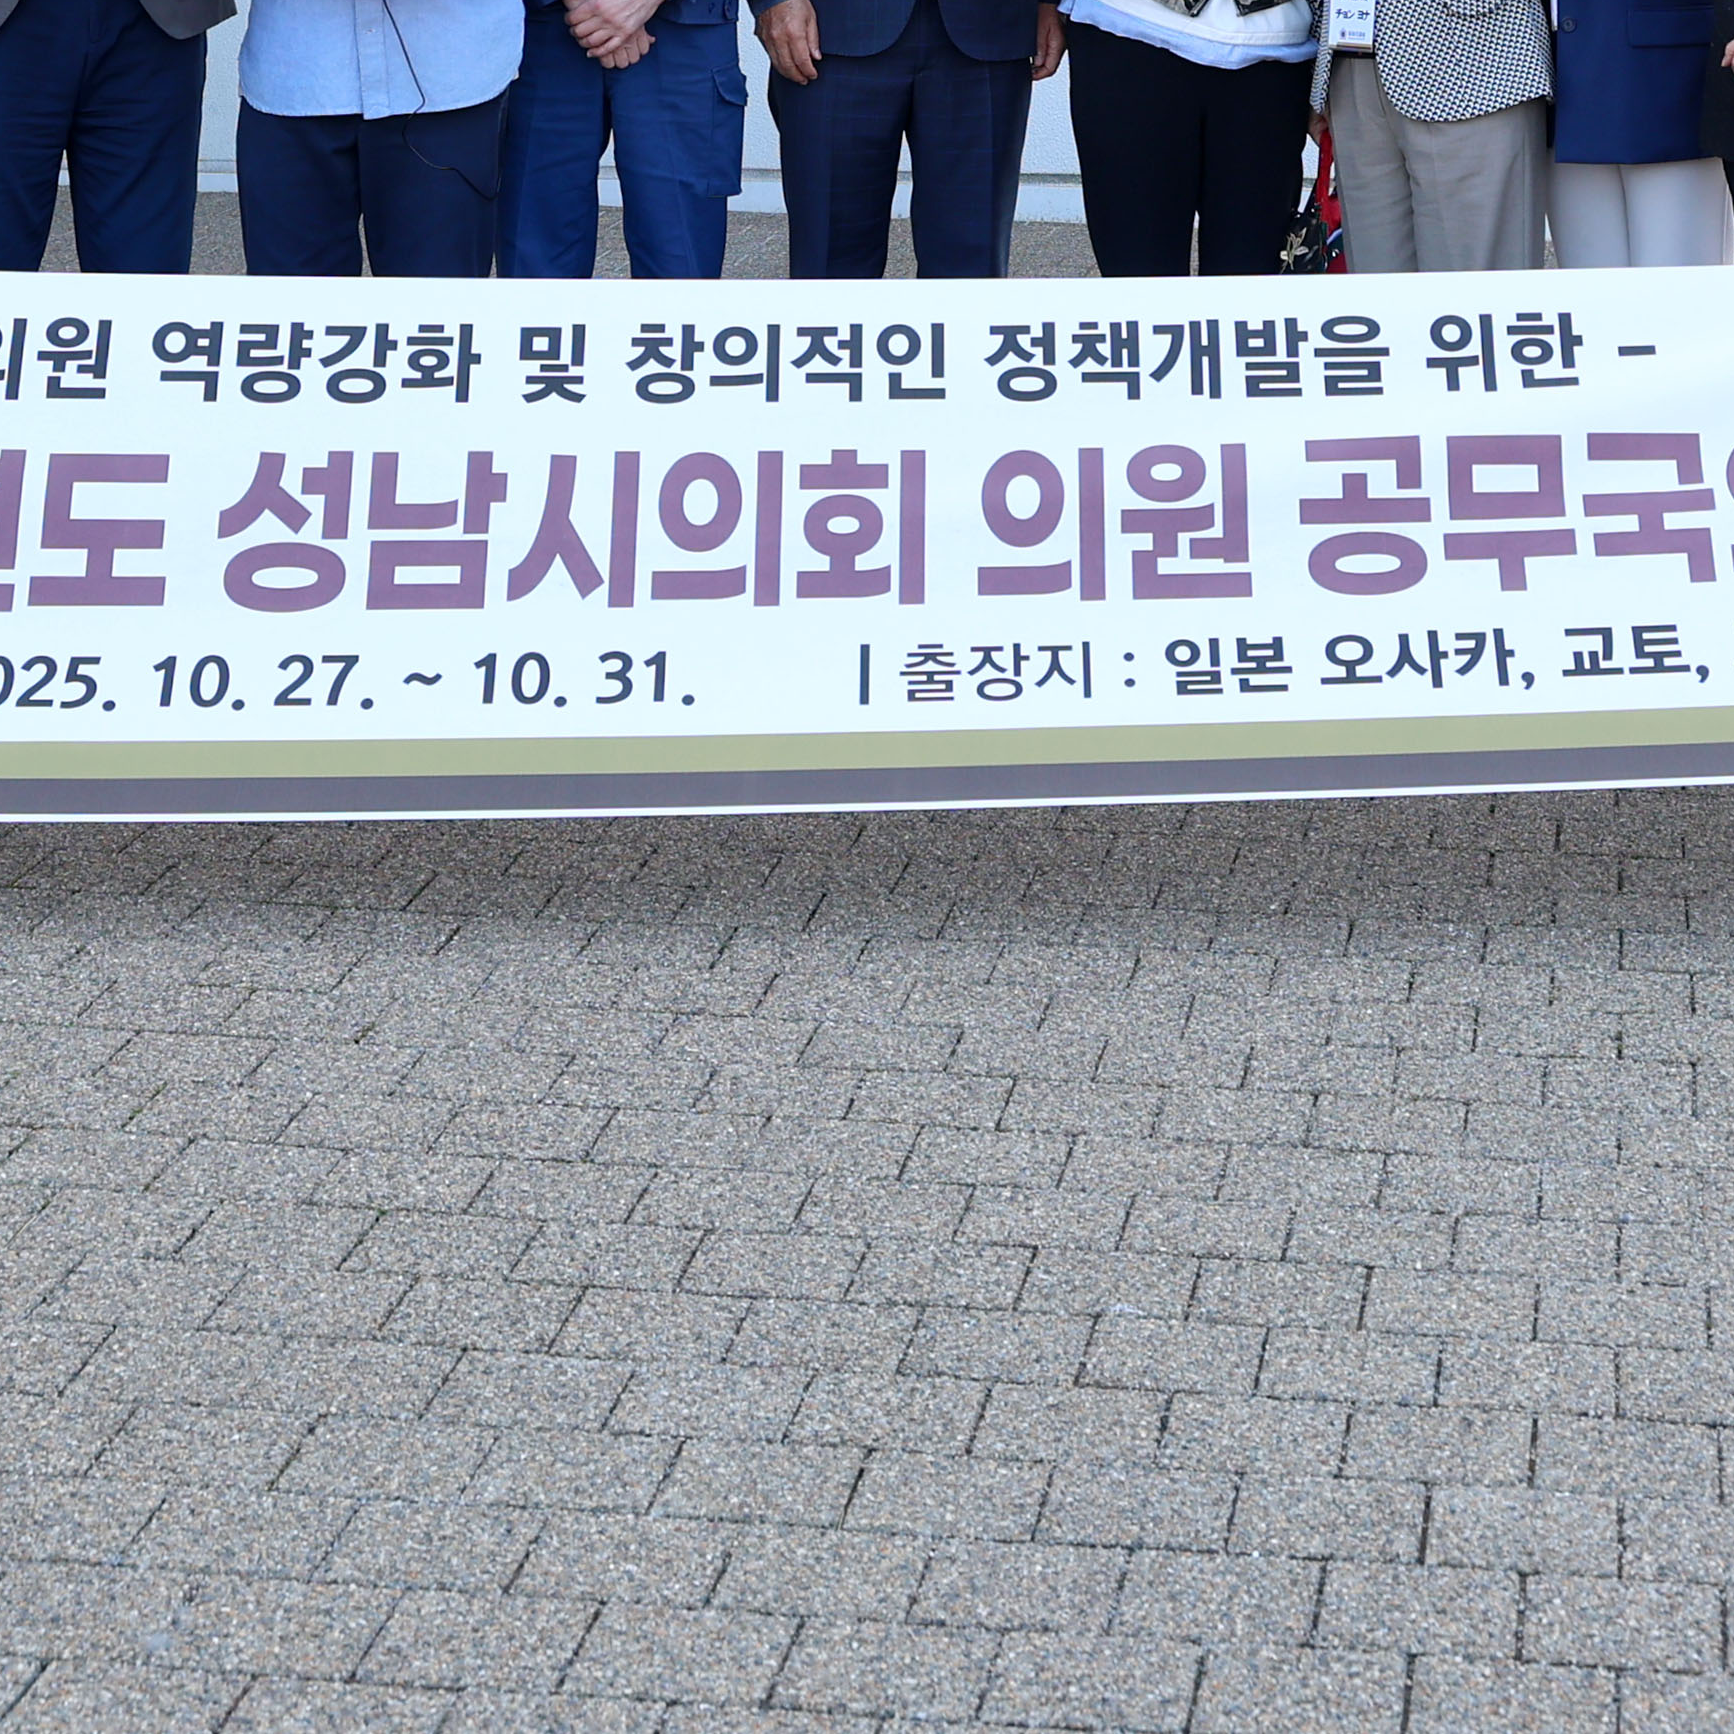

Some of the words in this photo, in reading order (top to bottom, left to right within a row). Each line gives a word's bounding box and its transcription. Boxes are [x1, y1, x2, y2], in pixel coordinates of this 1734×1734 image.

[151, 321, 482, 404] 역량강화
[518, 323, 587, 404] 및
[625, 322, 947, 405] 창의적인
[983, 315, 1390, 402] 정책개발을
[1425, 312, 1584, 393] 위한
[217, 448, 926, 613] 성남시의회
[977, 443, 1253, 601] 의원
[152, 654, 246, 712] 10.
[273, 653, 374, 711] 27.
[473, 651, 568, 708] 10.
[595, 650, 696, 707] 31.
[899, 640, 1092, 703] 출장지
[1164, 635, 1293, 696] 일본
[1320, 627, 1536, 691] 오사카,
[1561, 623, 1710, 684] 교토,
